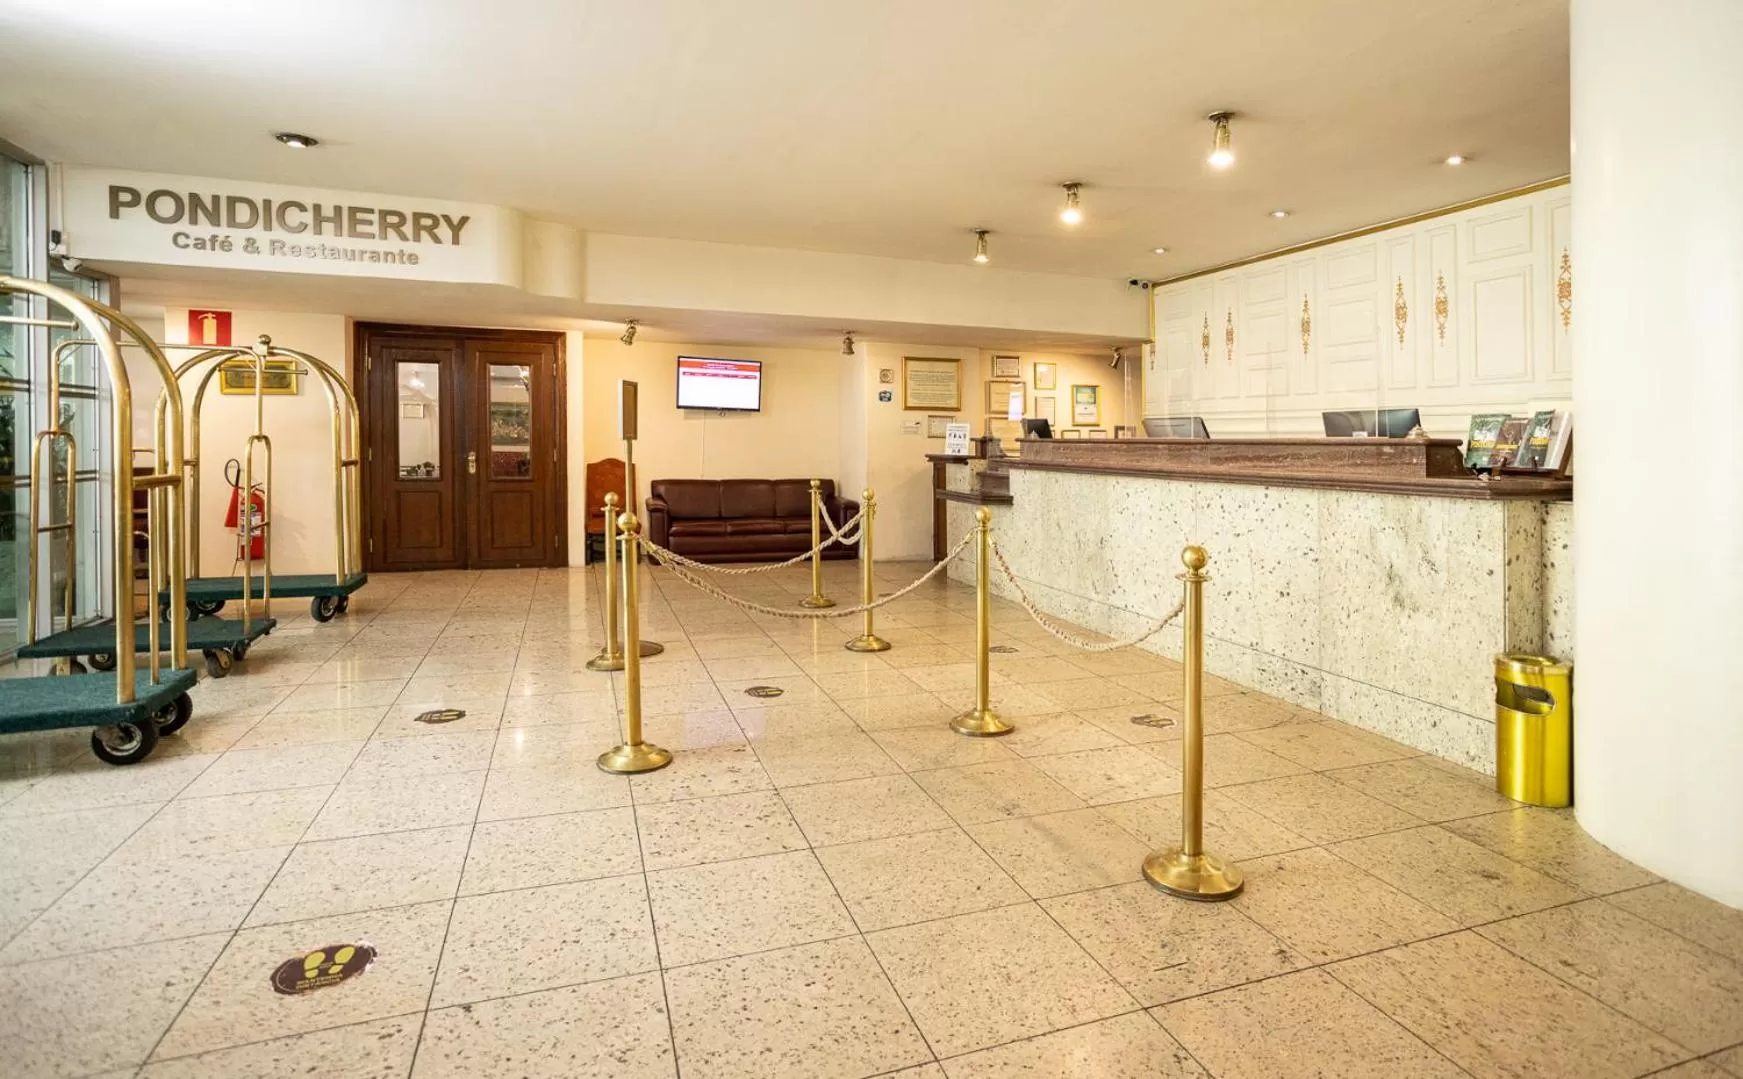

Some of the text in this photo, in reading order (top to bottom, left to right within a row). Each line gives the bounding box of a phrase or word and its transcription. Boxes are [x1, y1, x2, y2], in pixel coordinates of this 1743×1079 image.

[108, 184, 470, 245] PONDICHERRY
[172, 231, 419, 266] Café & Restaurante
